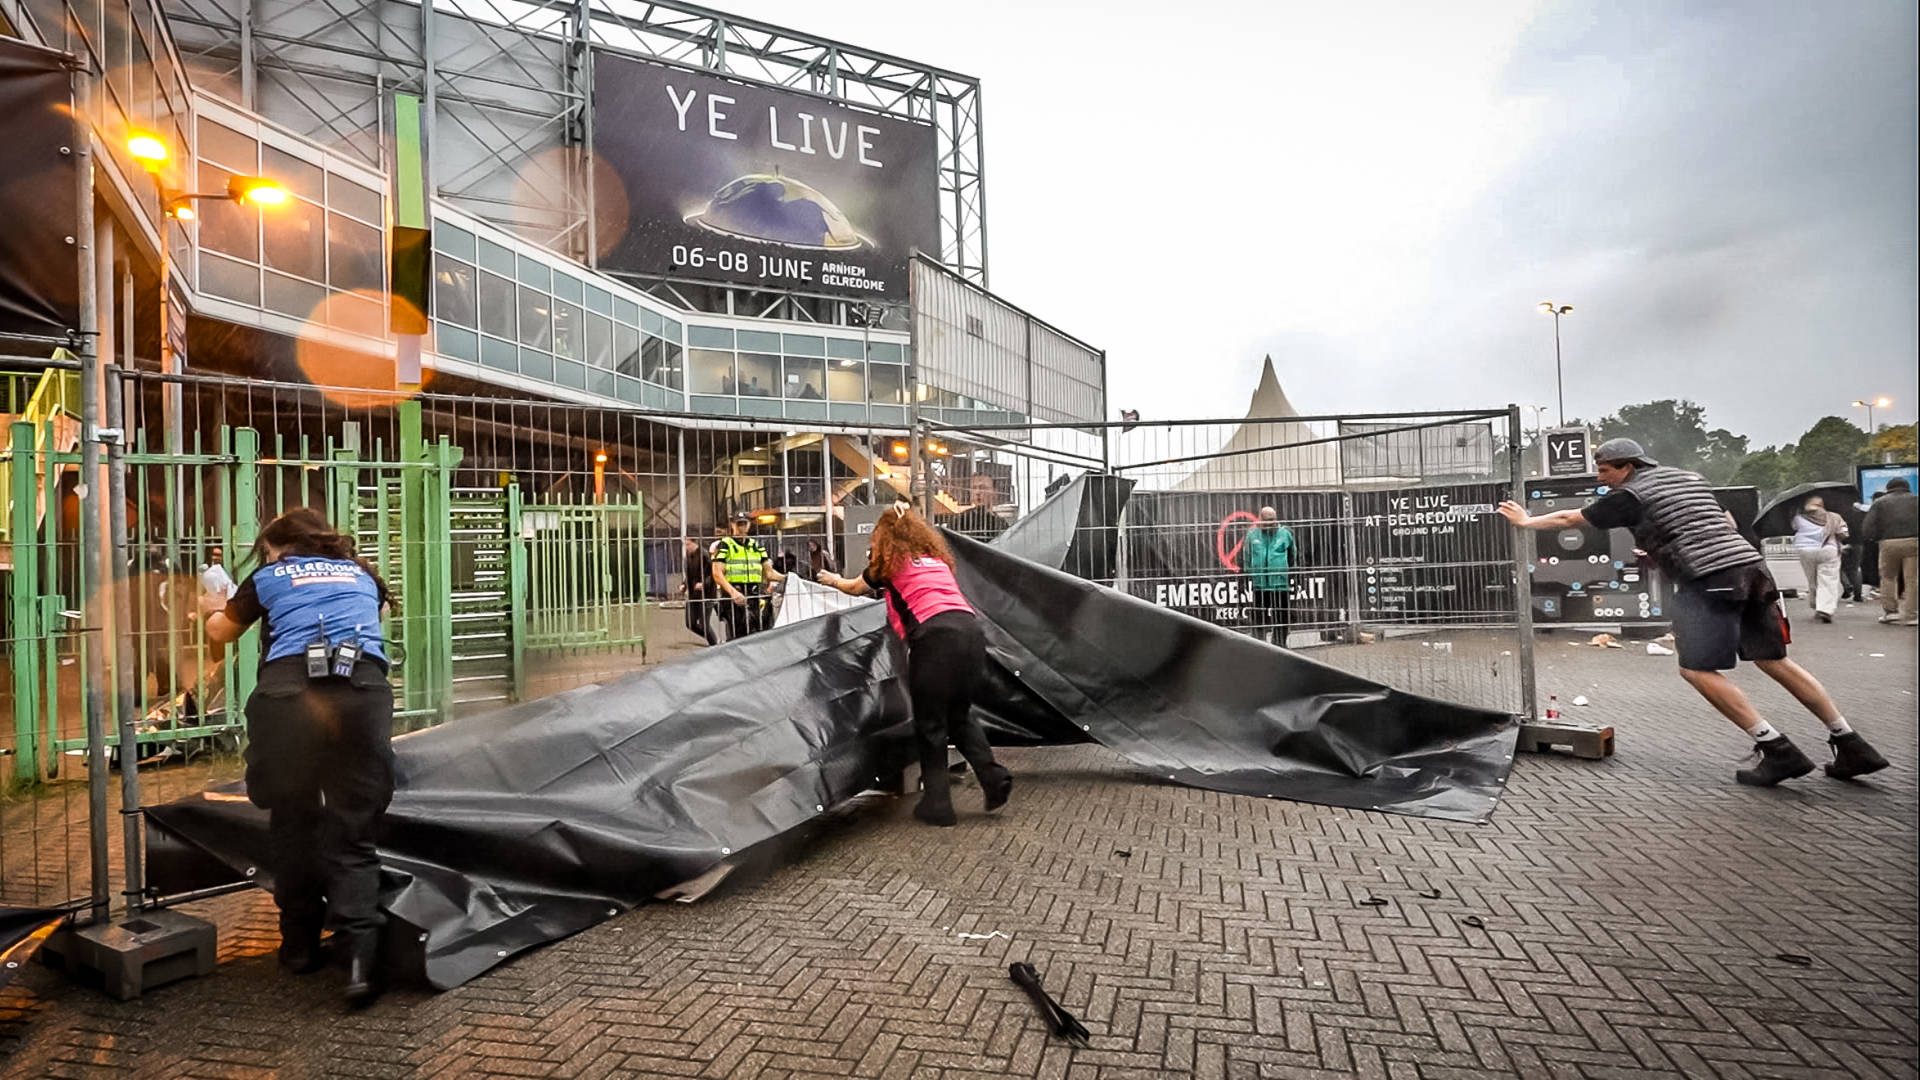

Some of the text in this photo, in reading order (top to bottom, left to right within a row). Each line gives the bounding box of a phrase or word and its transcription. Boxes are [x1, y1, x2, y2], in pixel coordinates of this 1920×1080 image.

[665, 84, 883, 168] YE LIVE
[671, 244, 814, 281] 06-08 JUNE
[821, 262, 867, 277] ARNHEM
[821, 274, 886, 292] GELREDOME
[1551, 440, 1583, 460] YE
[1391, 495, 1450, 510] YE LIVE
[1365, 513, 1479, 527] AT GELREDOME
[1392, 525, 1455, 536] GROUND PLAN
[1156, 580, 1254, 607] EMERGEN
[1216, 609, 1240, 620] KEEP
